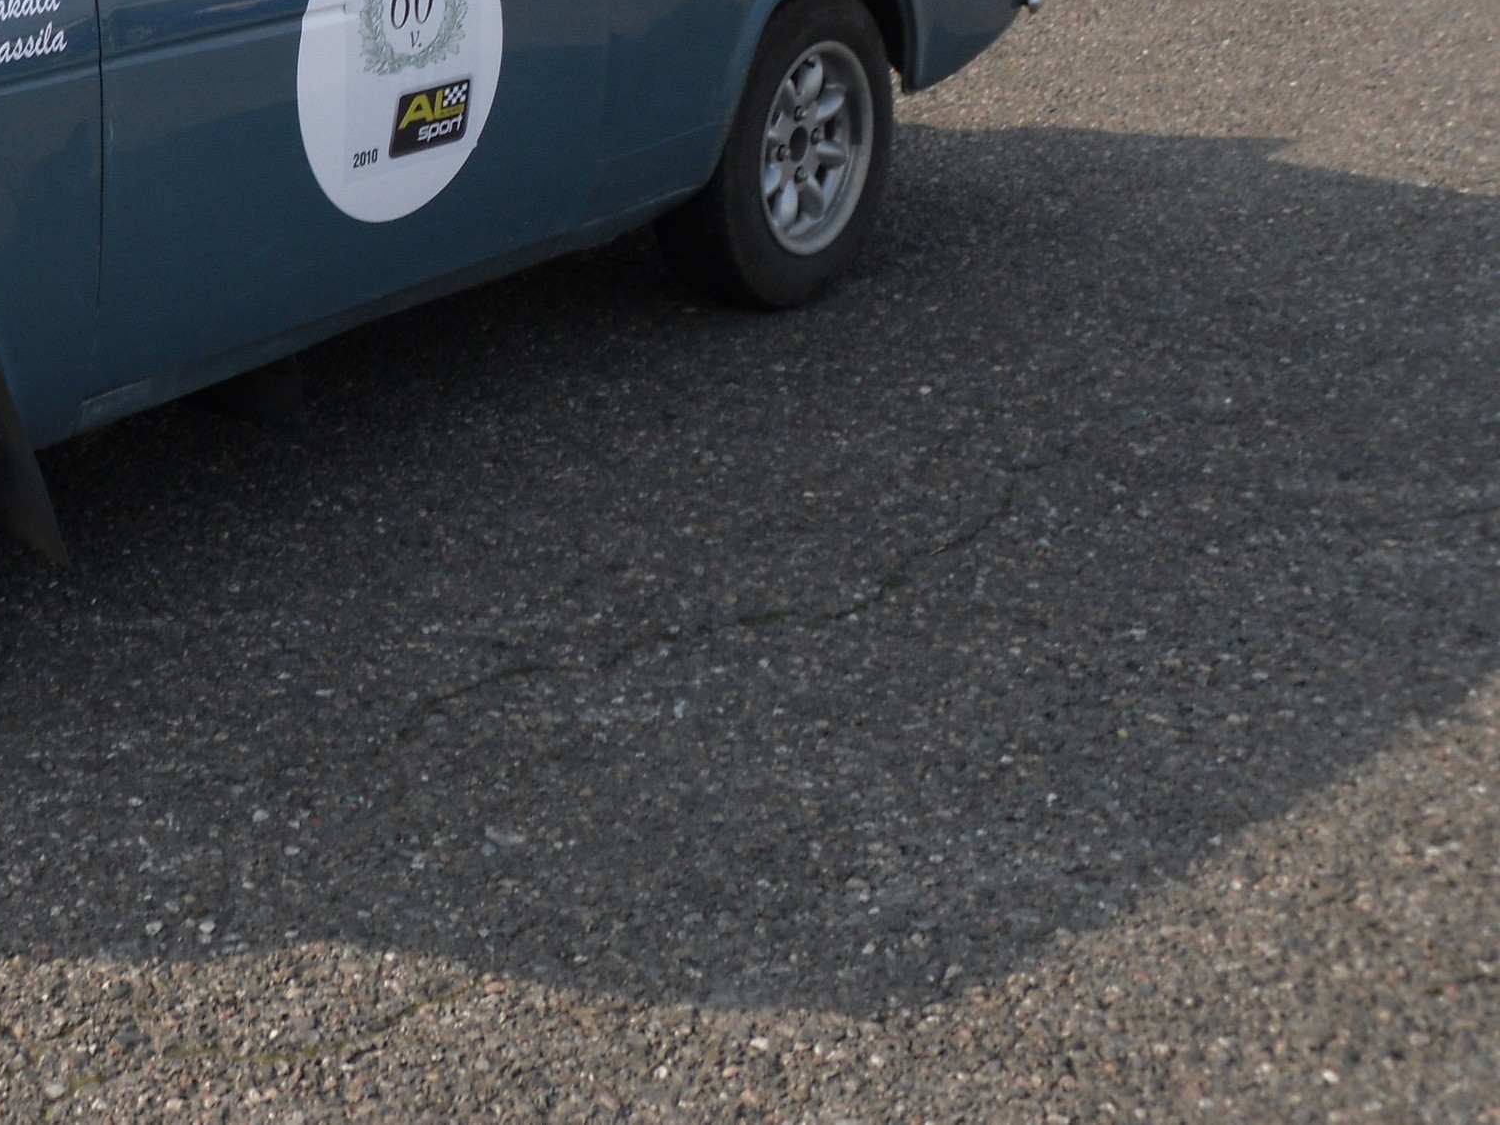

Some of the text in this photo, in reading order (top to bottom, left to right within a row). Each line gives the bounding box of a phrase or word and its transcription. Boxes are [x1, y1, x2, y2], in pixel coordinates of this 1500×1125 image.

[398, 89, 465, 130] AL
[418, 114, 463, 143] sport
[353, 148, 379, 169] 2010
